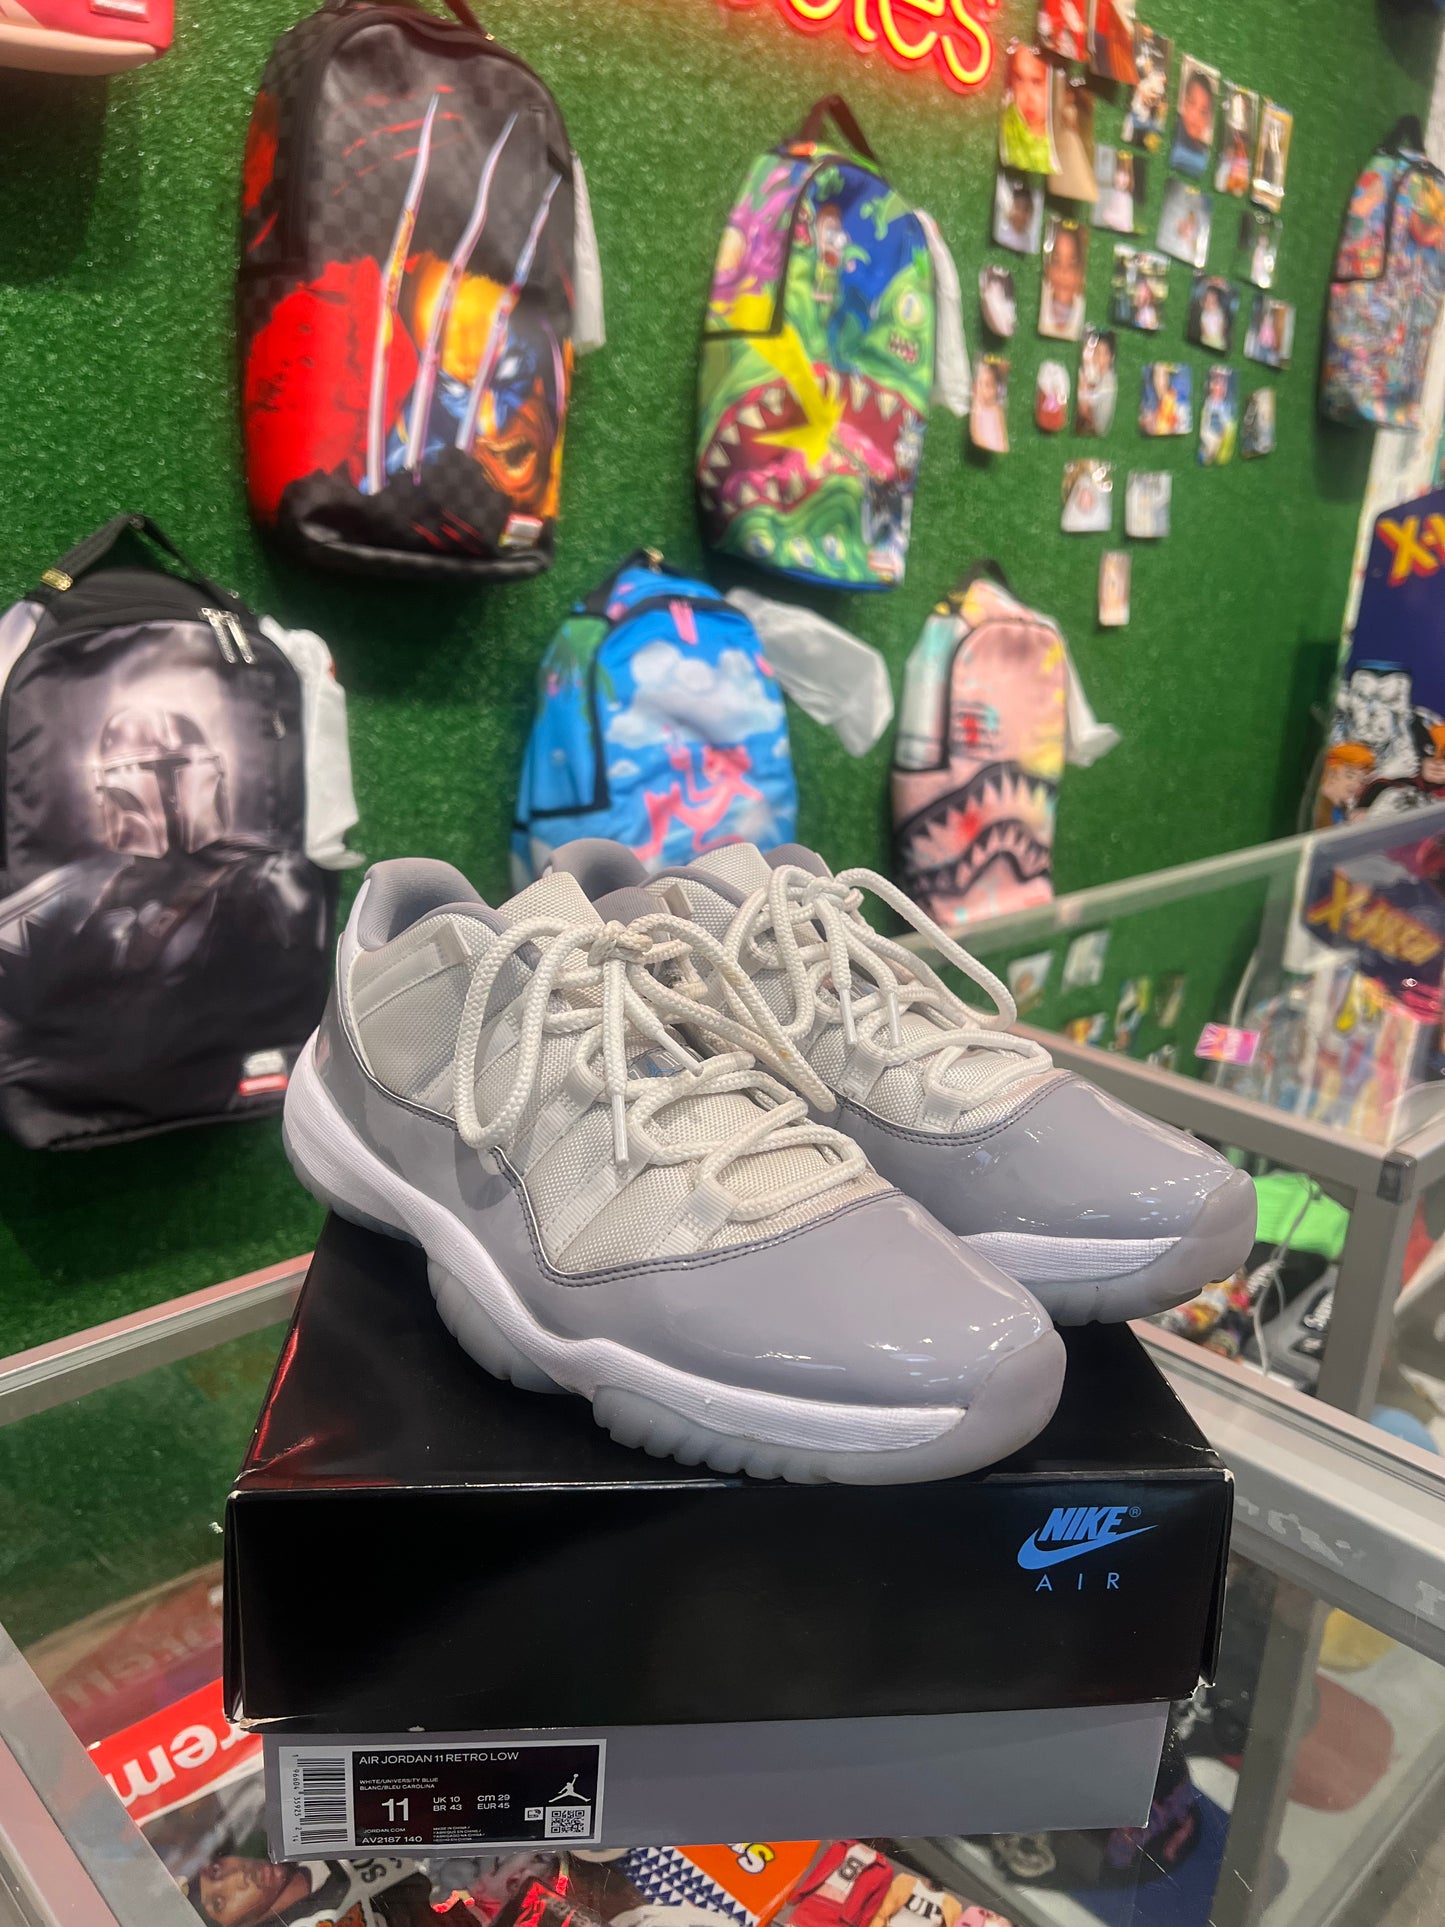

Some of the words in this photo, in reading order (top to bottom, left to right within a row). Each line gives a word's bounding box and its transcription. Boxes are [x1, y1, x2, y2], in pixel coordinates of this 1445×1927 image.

[1037, 1506, 1129, 1541] NIKE
[1035, 1572, 1120, 1592] AIR
[359, 1755, 380, 1765] AIR
[381, 1754, 433, 1764] JORDAN
[434, 1754, 444, 1763] 11
[446, 1752, 488, 1762] RETRO
[490, 1751, 520, 1761] LOW
[433, 1796, 447, 1804] UK
[381, 1798, 409, 1822] 11
[433, 1804, 447, 1812] BR
[362, 1836, 401, 1844] AV2187
